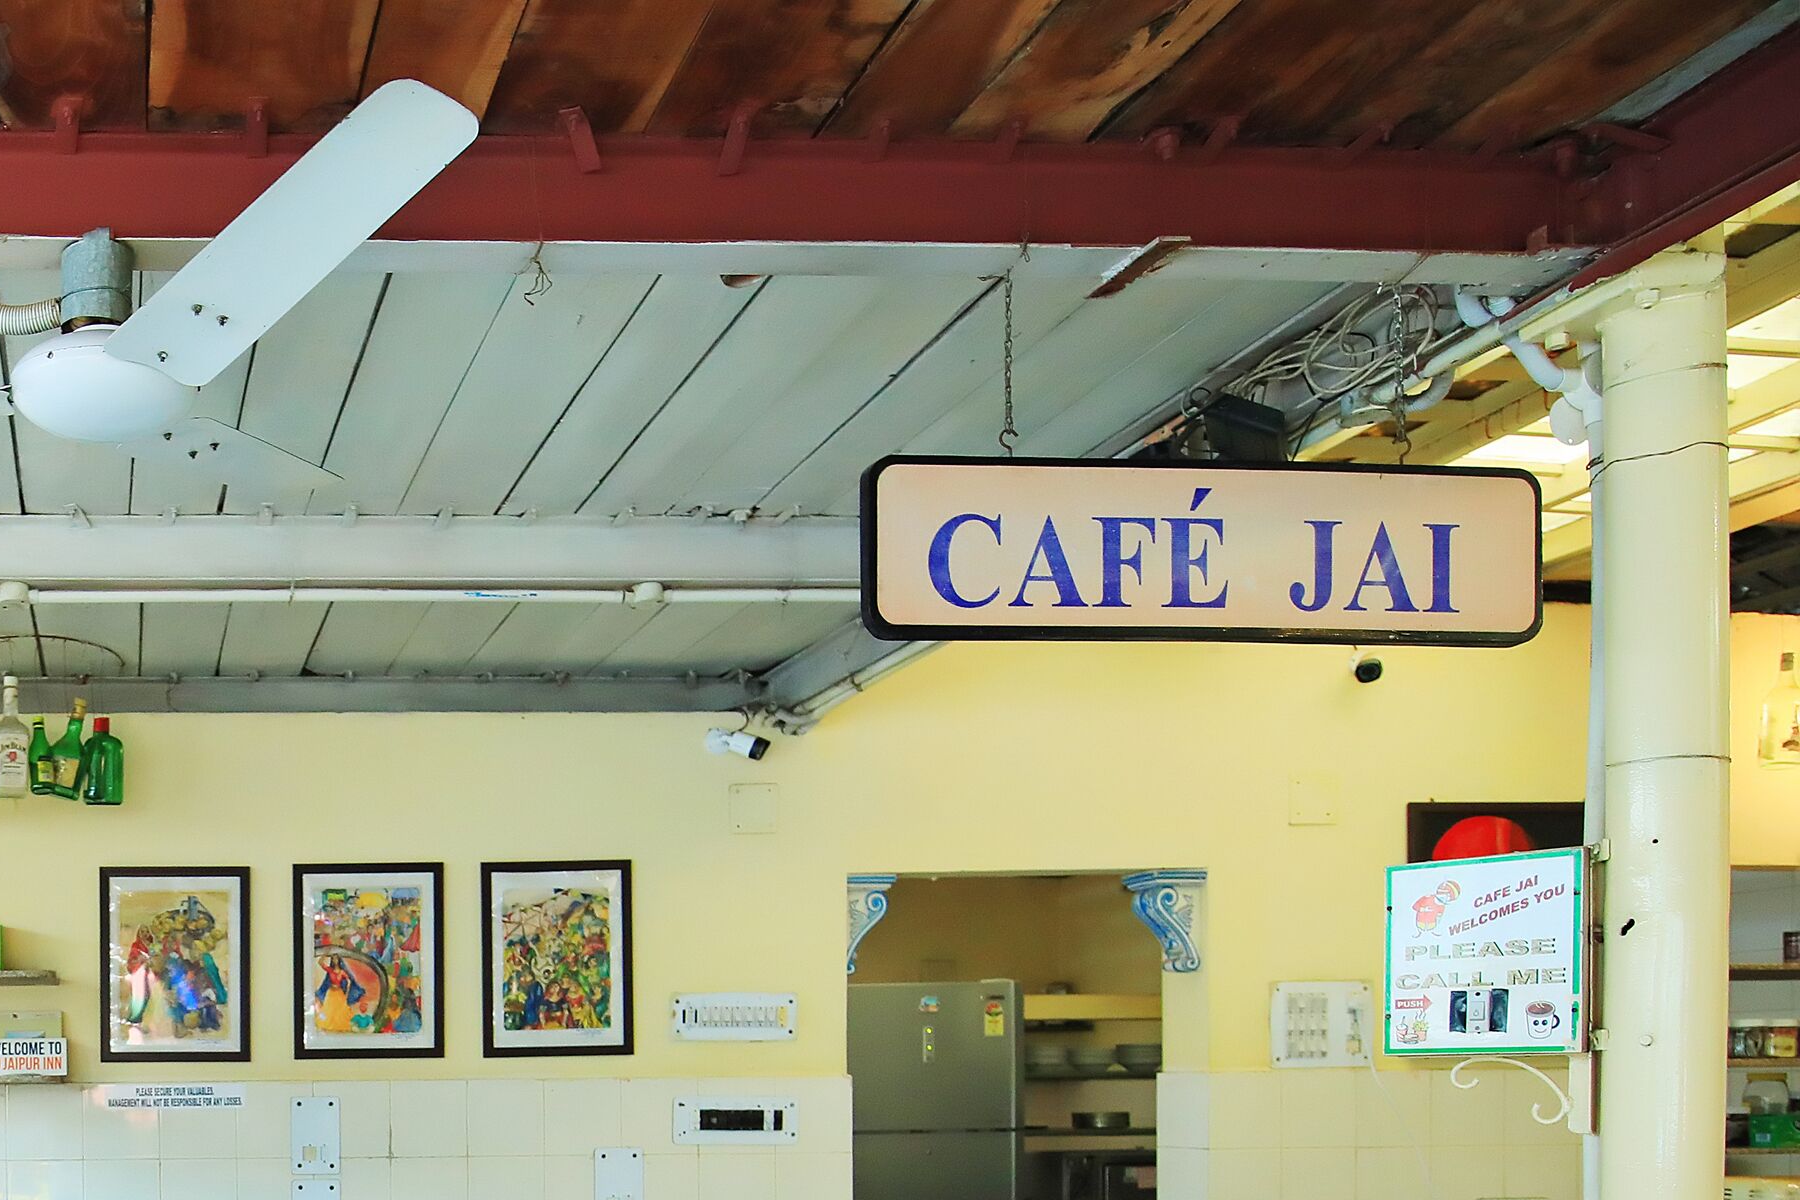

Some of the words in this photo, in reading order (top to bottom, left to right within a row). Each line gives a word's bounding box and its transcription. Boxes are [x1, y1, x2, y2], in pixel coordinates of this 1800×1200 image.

[927, 487, 1230, 610] CAFÉ
[1289, 518, 1462, 614] JAI
[1473, 885, 1511, 909] CAFE
[1515, 874, 1539, 896] JAI
[1448, 899, 1530, 937] WELCOMES
[1534, 883, 1566, 905] YOU
[1404, 937, 1557, 962] PLEASE
[1395, 970, 1495, 990] CALL
[1506, 967, 1567, 987] ME
[1397, 999, 1425, 1009] PUSH
[43, 1041, 62, 1055] TO
[2, 1056, 41, 1071] JAIPUR
[43, 1056, 62, 1070] INN
[135, 1087, 153, 1097] PLEASE
[154, 1087, 172, 1096] SECURE
[173, 1087, 186, 1096] YOUR
[108, 1098, 140, 1108] MANAGEMENT
[141, 1098, 152, 1108] WILL
[153, 1098, 163, 1107] NOT
[163, 1098, 170, 1107] BE
[171, 1097, 202, 1107] RESPONSIBLE
[202, 1097, 212, 1107] FOR
[213, 1097, 223, 1106] ANY
